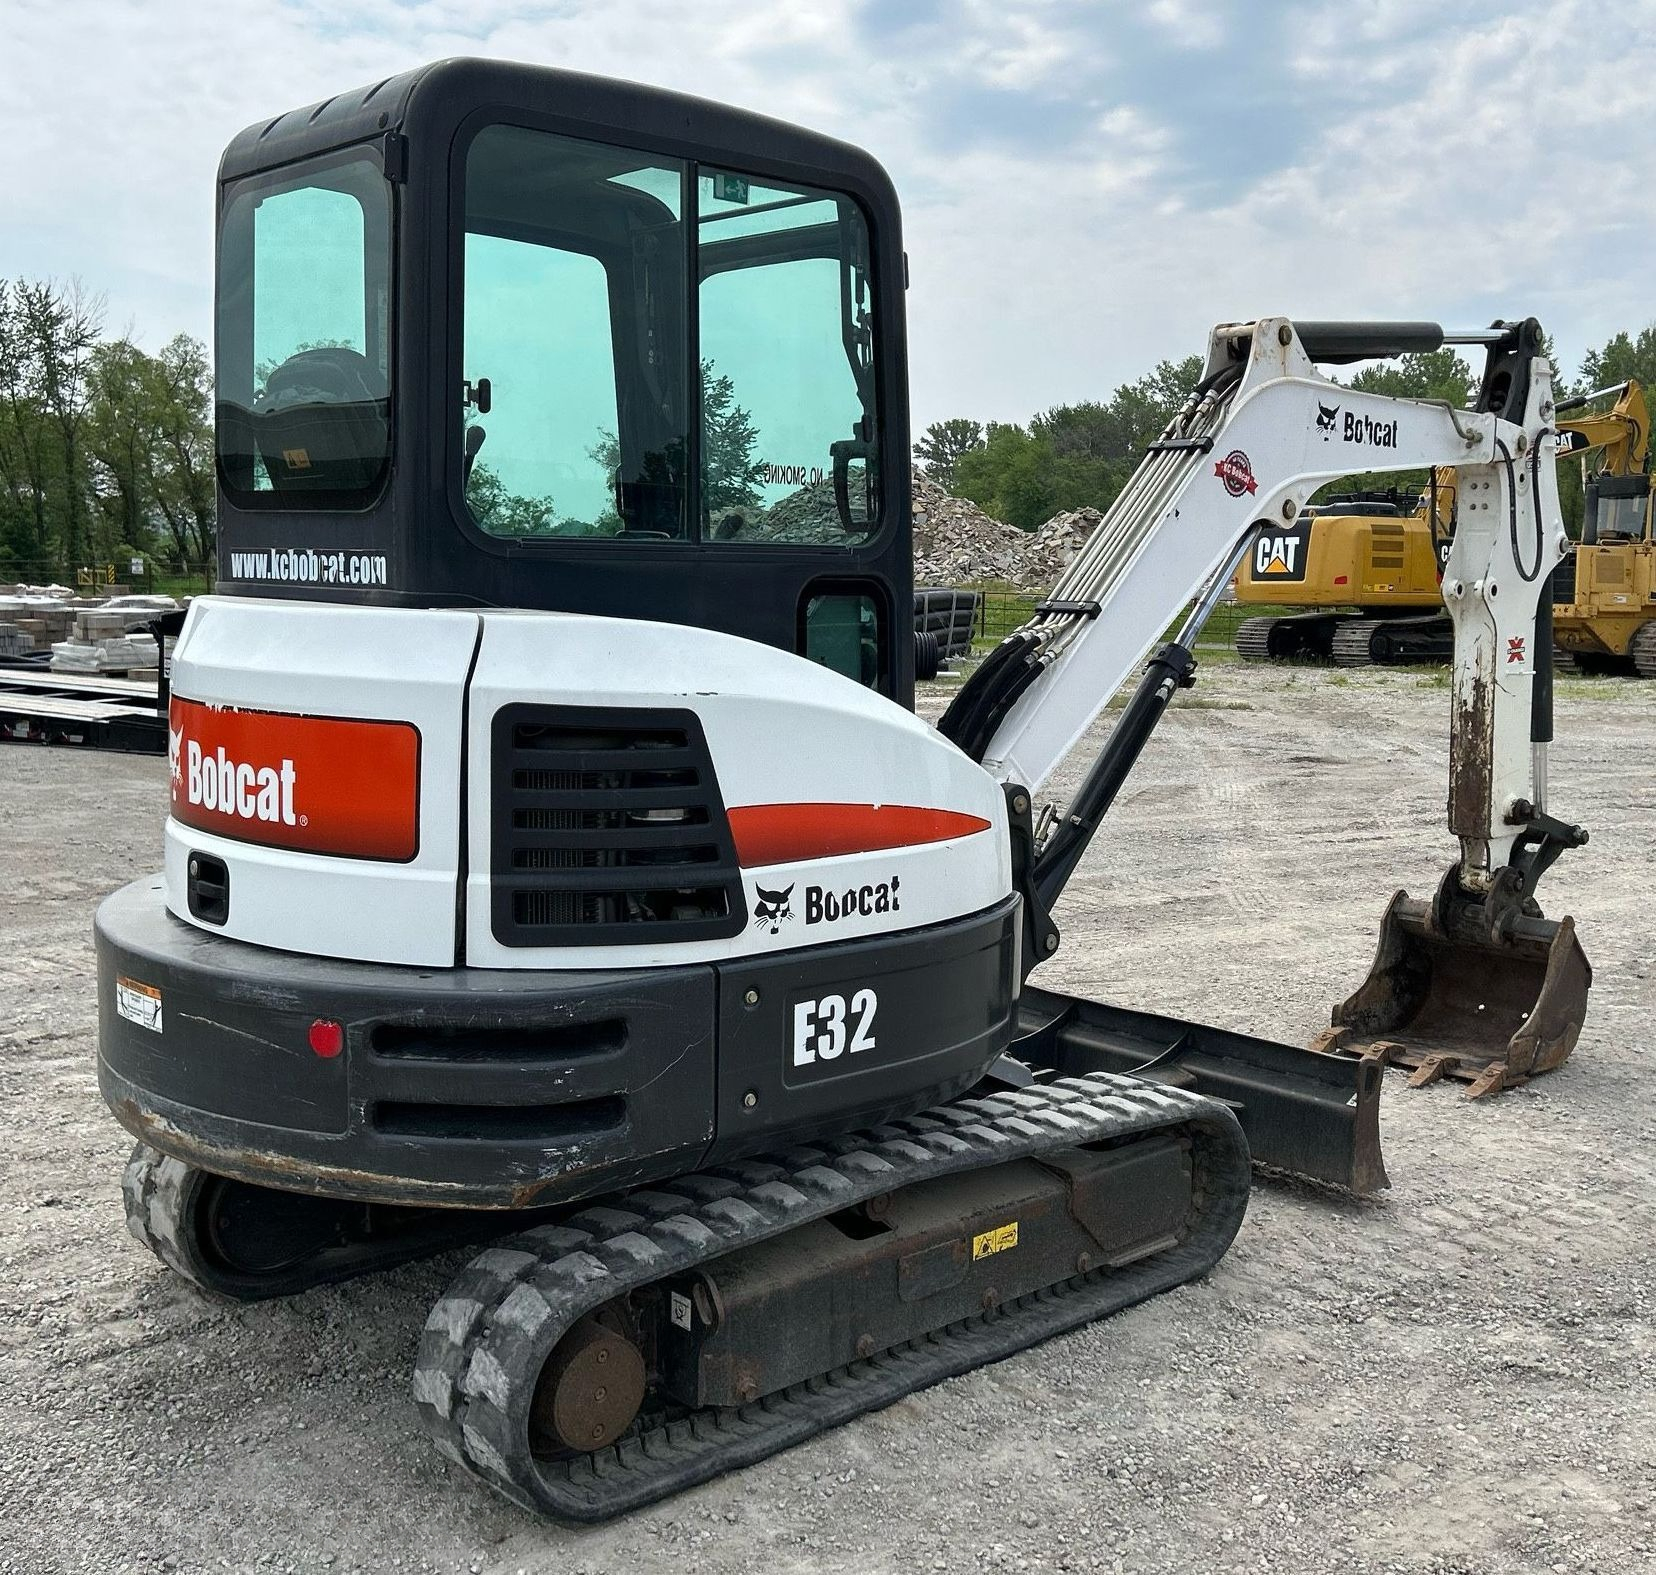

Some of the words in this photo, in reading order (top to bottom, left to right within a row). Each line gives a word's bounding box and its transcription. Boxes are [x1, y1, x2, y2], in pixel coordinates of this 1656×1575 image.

[1344, 411, 1397, 448] Bobcat
[231, 548, 387, 585] www.kcbobcat.com
[1256, 536, 1299, 573] CAT
[805, 875, 900, 925] Bobcat
[793, 988, 878, 1067] E32
